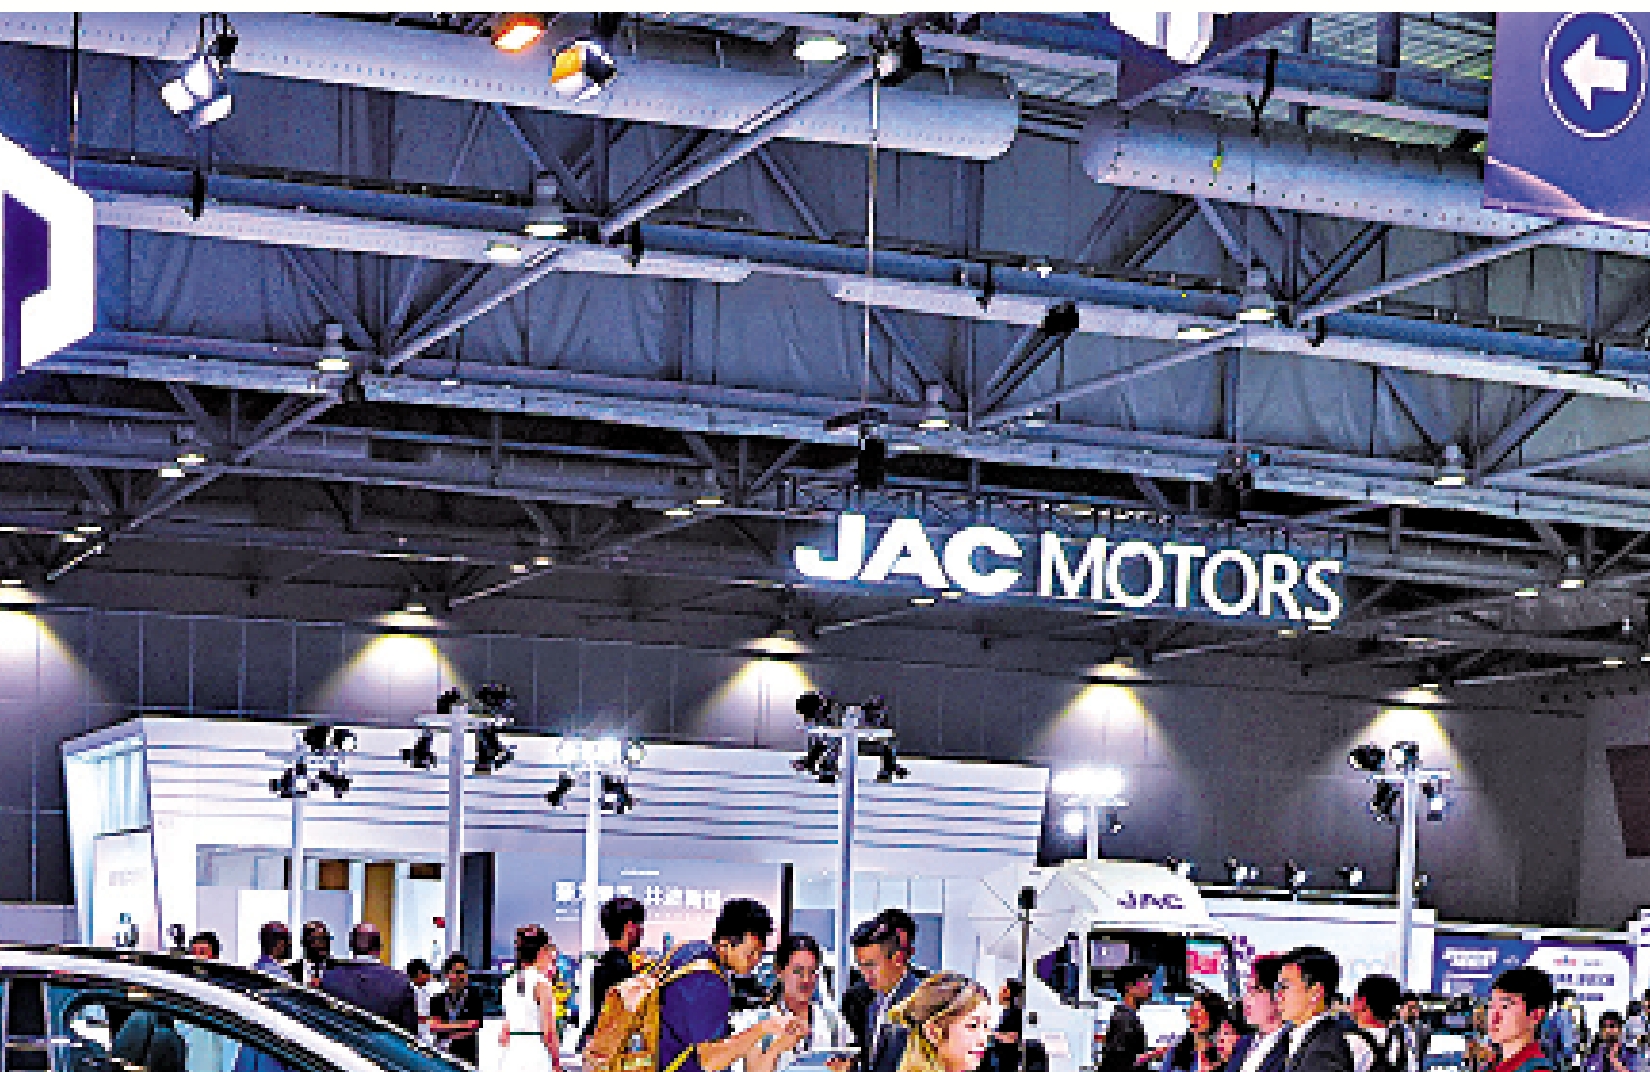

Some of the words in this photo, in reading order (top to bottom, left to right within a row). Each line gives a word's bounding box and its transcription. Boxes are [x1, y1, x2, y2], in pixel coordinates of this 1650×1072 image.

[794, 513, 1025, 596] JAC
[1038, 530, 1344, 625] MOTORS
[1117, 890, 1186, 910] JAC
